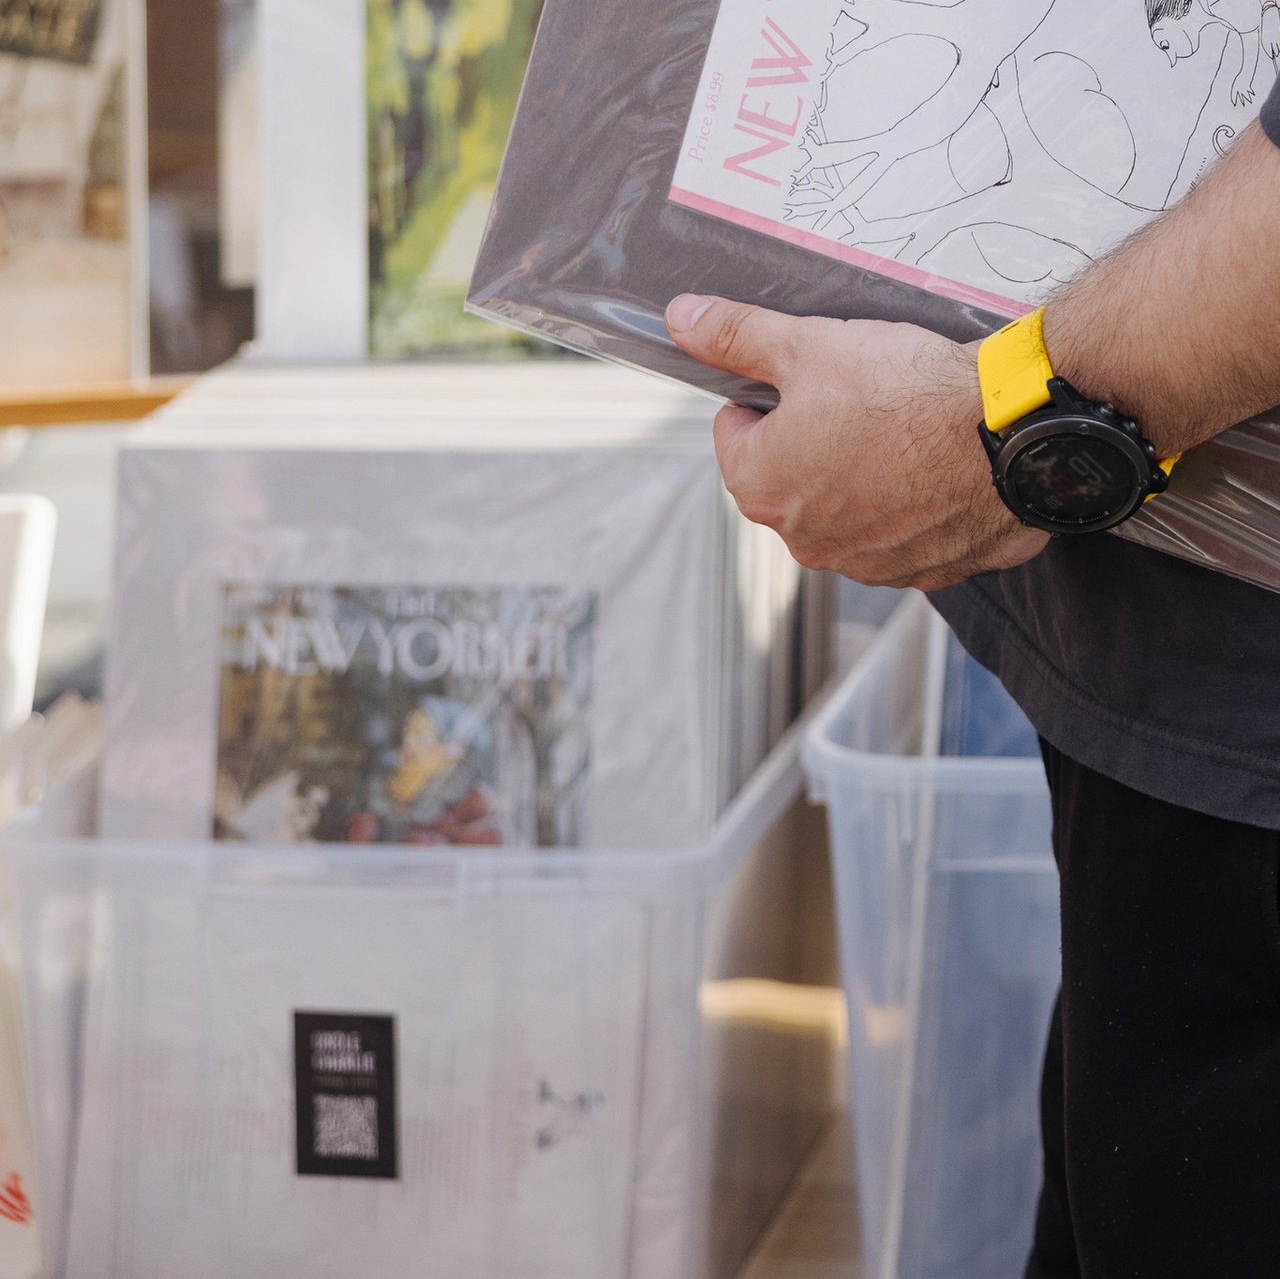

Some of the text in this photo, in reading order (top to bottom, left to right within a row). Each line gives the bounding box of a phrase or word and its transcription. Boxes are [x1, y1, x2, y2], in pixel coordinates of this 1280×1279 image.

[688, 71, 725, 162] Price $8.99
[722, 15, 813, 187] NEW
[244, 615, 569, 681] NEW YORKER
